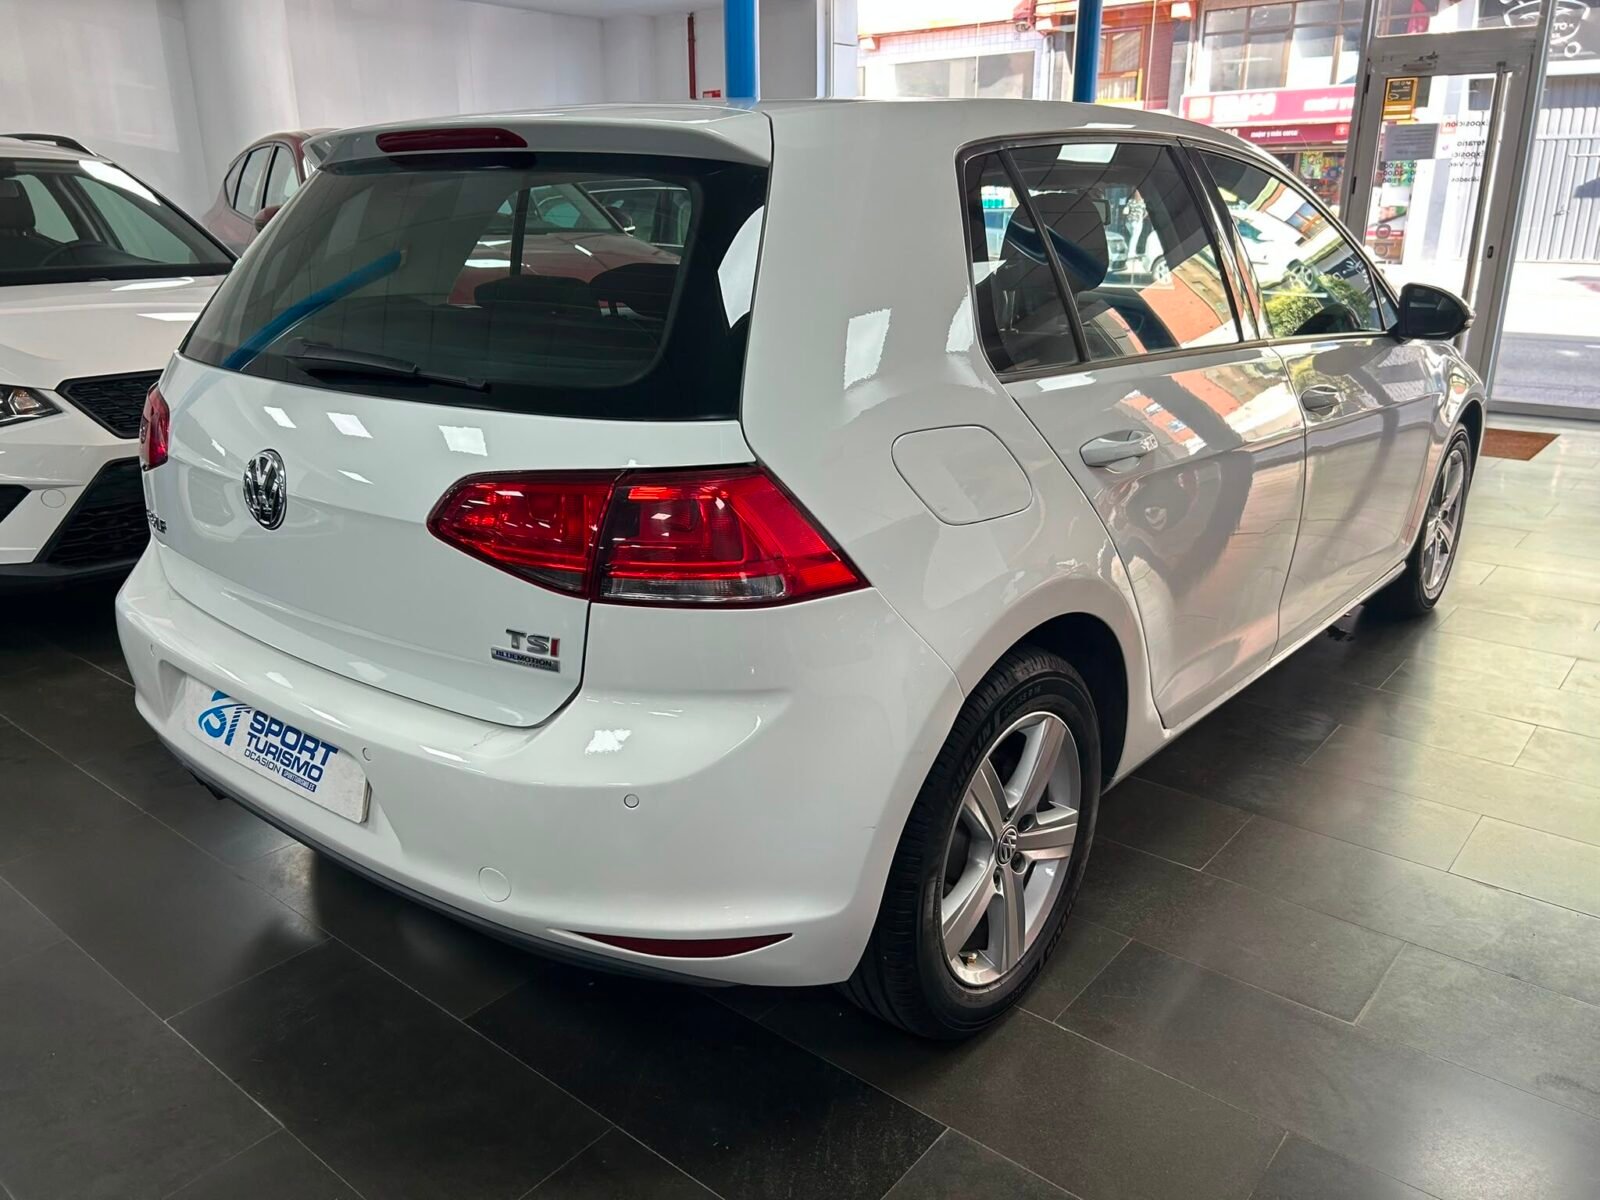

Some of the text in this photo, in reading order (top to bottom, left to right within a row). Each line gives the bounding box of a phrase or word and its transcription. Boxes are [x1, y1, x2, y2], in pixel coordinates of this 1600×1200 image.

[244, 749, 283, 776] OCASION
[246, 732, 324, 783] TURISMO
[249, 710, 339, 767] SPORT
